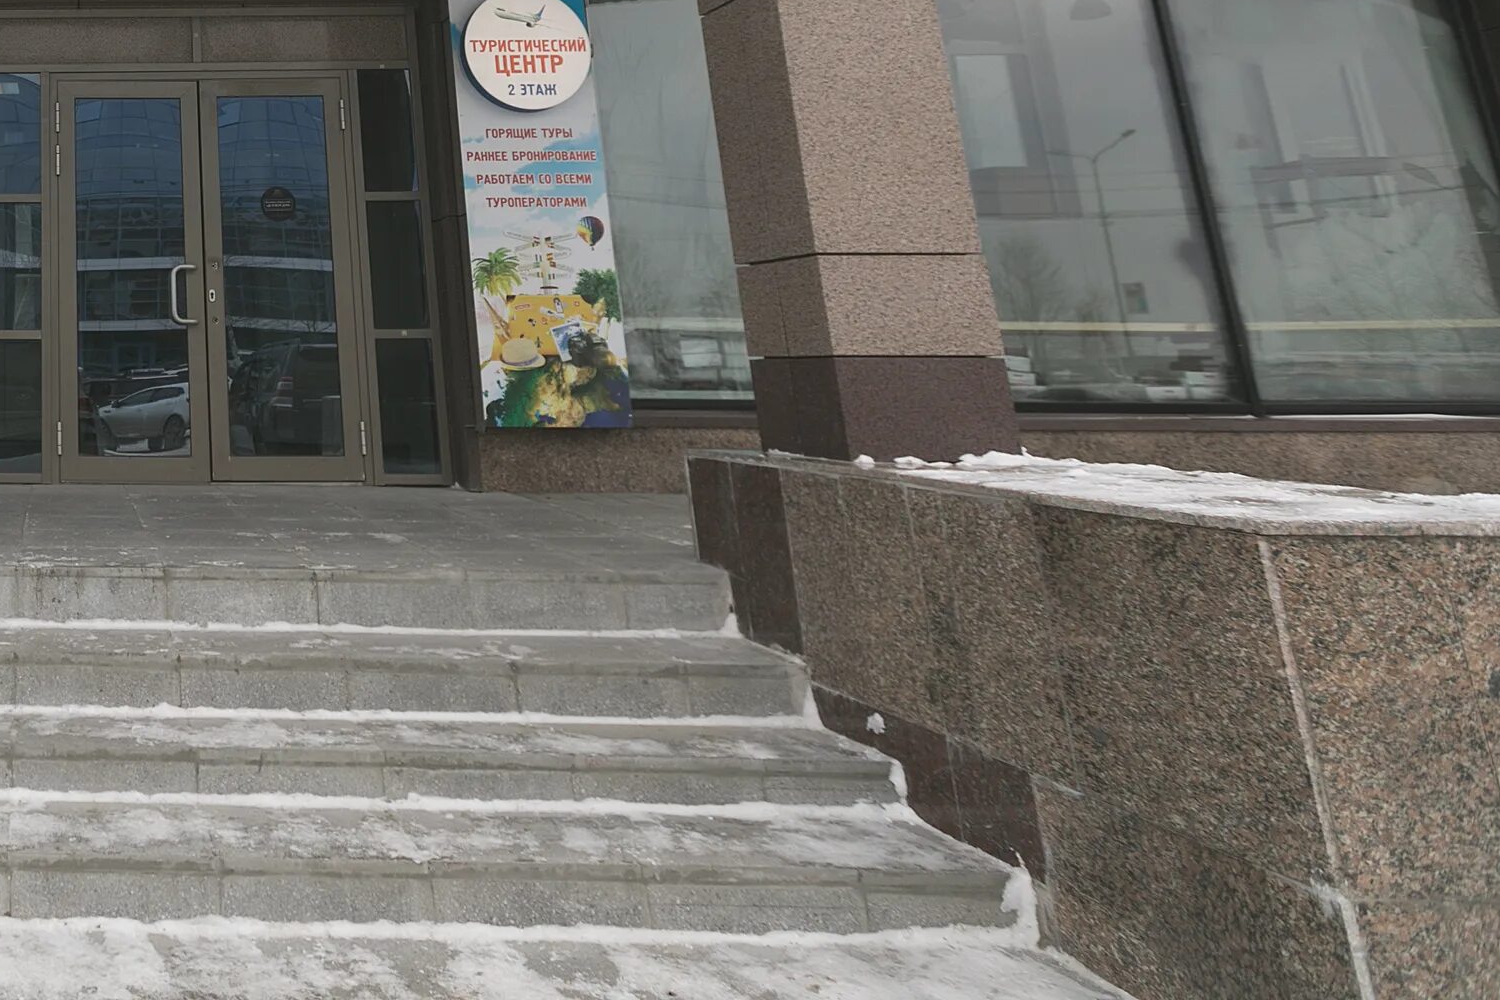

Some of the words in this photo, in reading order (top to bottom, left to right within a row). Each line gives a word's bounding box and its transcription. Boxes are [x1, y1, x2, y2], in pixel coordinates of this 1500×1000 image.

[469, 37, 587, 53] ТУРИСТИЧЕСКИЙ
[494, 55, 564, 77] ЦЕНТР
[507, 84, 515, 96] 2
[520, 84, 557, 96] ЭТАЖ
[485, 128, 538, 140] ГОРЯЩИЕ
[541, 128, 573, 138] ТУРЫ
[466, 151, 508, 161] РАННЕЕ
[512, 151, 597, 161] БРОНИРОВАНИЕ
[476, 174, 535, 185] РАБОТАЕМ
[539, 174, 552, 184] СО
[556, 174, 592, 184] ВСЕМИ
[486, 197, 587, 208] ТУРОПЕРАТОРАМИ
